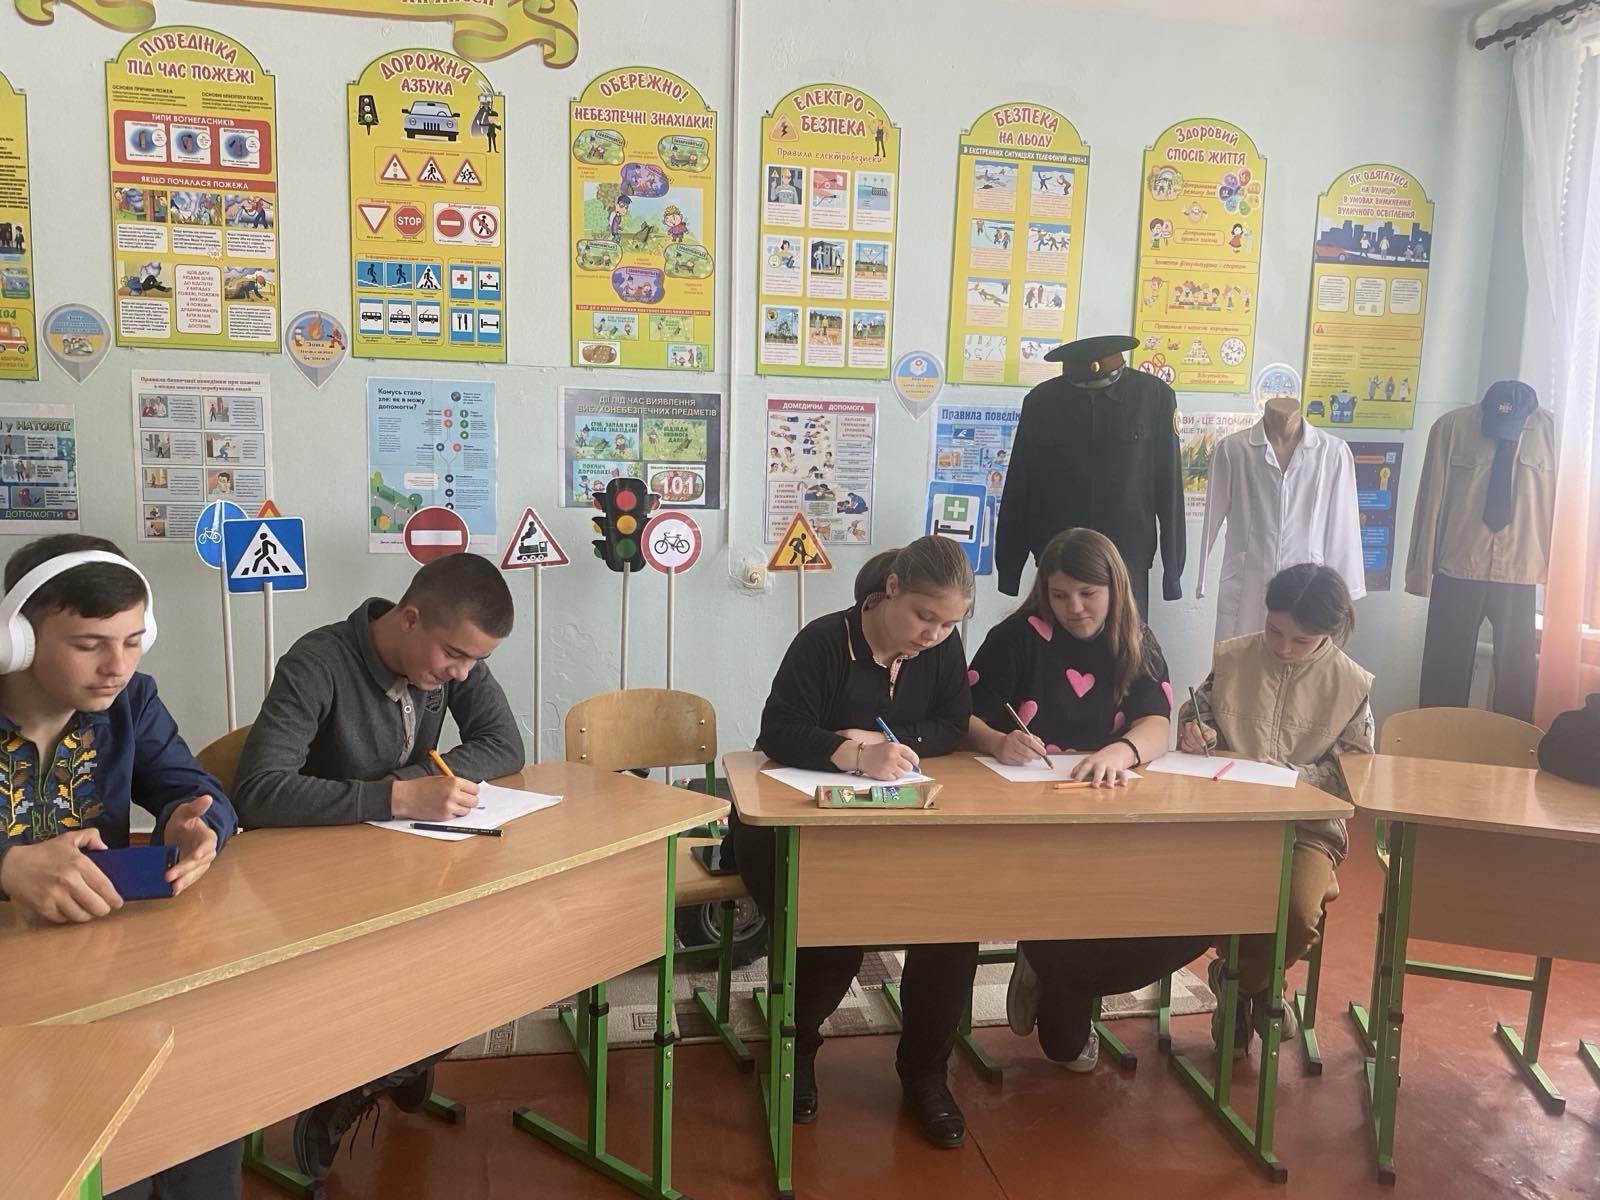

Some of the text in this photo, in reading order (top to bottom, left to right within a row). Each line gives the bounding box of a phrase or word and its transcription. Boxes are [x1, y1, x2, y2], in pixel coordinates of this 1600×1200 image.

[139, 33, 238, 64] ПОВЕДІНКА
[128, 59, 255, 84] ПІД ЧАС ПОЖЕЖІ
[380, 54, 473, 84] ДОРОЖНЯ
[401, 78, 454, 96] АЗБУКА
[600, 73, 690, 102] ОБЕРЕЖНО!
[793, 90, 864, 112] ЕЛЕКТРО
[152, 113, 234, 127] ТИПИ ВОГНЕГАСНИКІВ
[574, 107, 714, 129] НЕБЕЗПЕЧНІ ЗНАХІДКИ!
[801, 115, 866, 137] БЕЗПЕКА
[994, 108, 1059, 132] БЕЗПЕКА
[999, 132, 1052, 148] НА ЛЬОДУ
[1176, 126, 1238, 146] Здоровий
[778, 147, 882, 166] Правила електробезпеки
[1167, 148, 1246, 165] СПОСІБ ЖИТТЯ
[141, 176, 249, 190] ЯКЩО ПОЧАЛАСЯ ПОЖЕЖА
[1349, 170, 1409, 189] ЯК ОДЯГАТИСЬ
[398, 216, 422, 226] STOP
[378, 388, 402, 396] Комусь
[628, 397, 644, 405] ЧАС
[646, 397, 696, 406] ВИЯВЛЕННЯ
[782, 402, 865, 412] ДОМЕДИЧНА ДОПОМОГА
[672, 408, 717, 417] ПРЕДМЕТІВ
[942, 409, 982, 421] Правила
[1201, 416, 1214, 426] ЦЕ
[660, 478, 694, 495] 101
[5, 511, 64, 519] ДОПОМОГТИ
